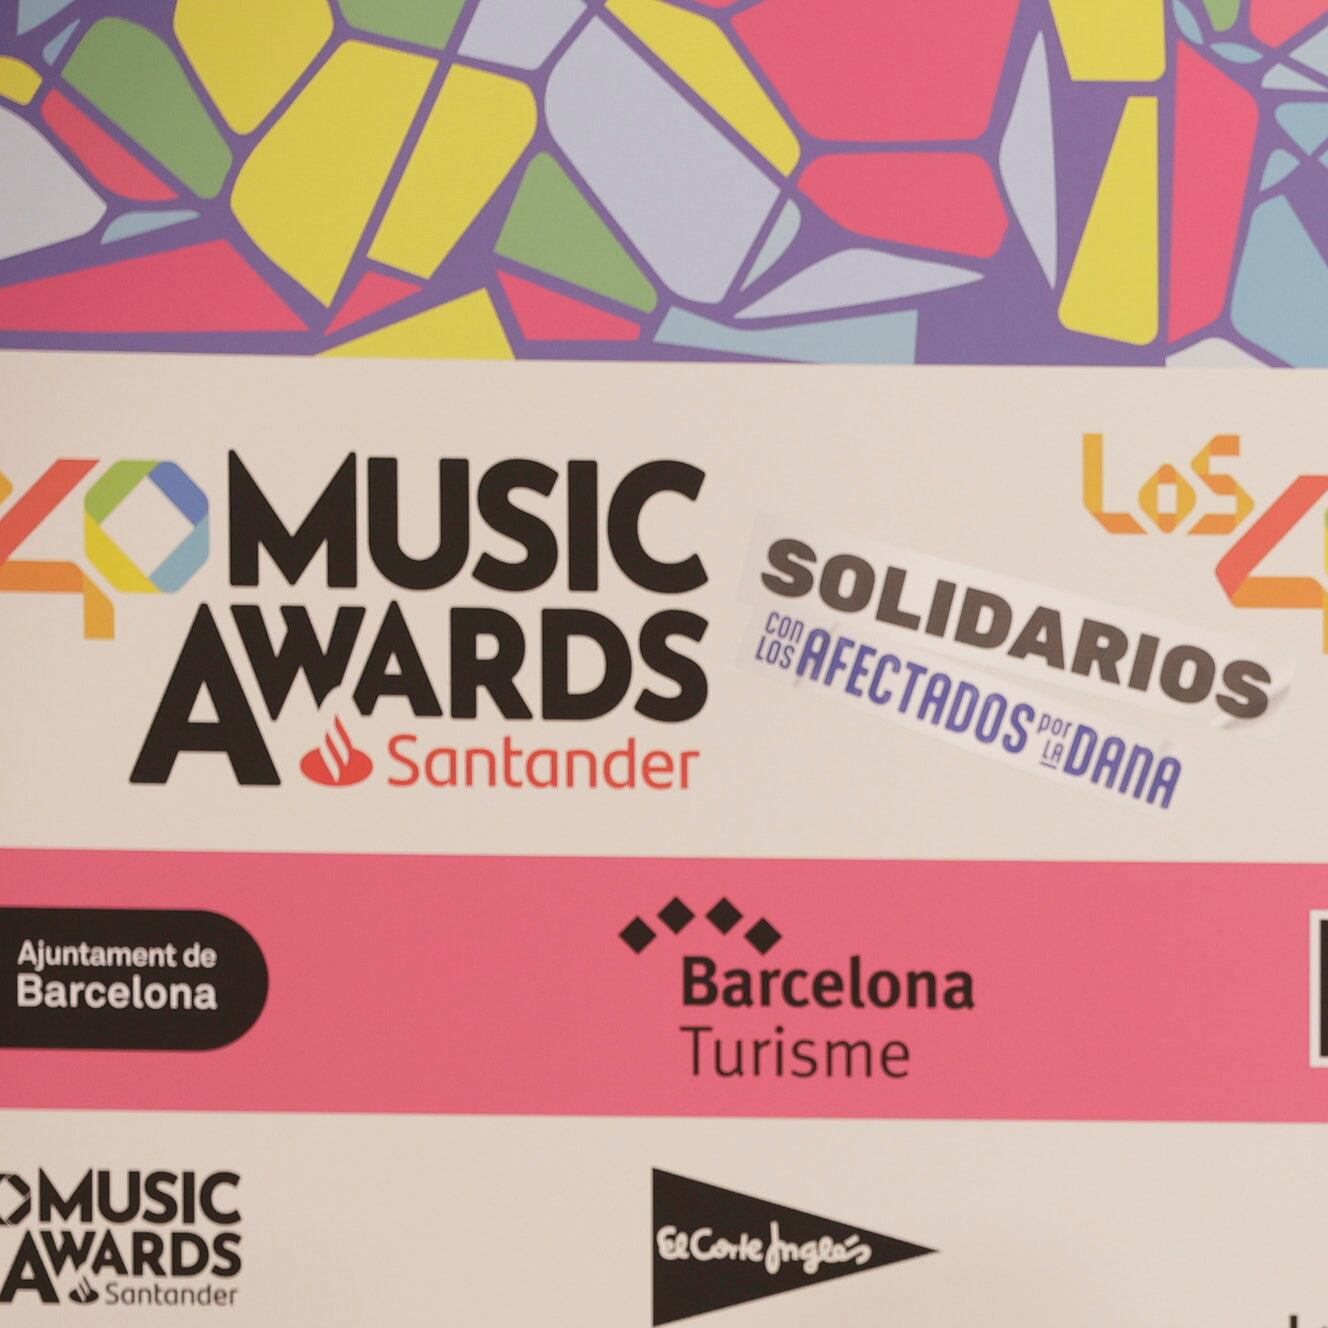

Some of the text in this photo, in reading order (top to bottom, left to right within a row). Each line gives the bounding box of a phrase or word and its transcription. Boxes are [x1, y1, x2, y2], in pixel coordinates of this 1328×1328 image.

[228, 449, 709, 594] MUSIC
[761, 538, 1272, 720] SOLIDARIOS
[129, 600, 710, 787] AWARDS
[755, 628, 1035, 754] LOS AFECTADOS
[387, 734, 701, 791] Santander
[1063, 724, 1181, 809] DANA
[17, 940, 218, 972] Ajuntament de
[682, 955, 974, 1010] Barcelona
[15, 973, 218, 1011] Barcelona
[680, 1025, 911, 1079] Turisme
[38, 1168, 241, 1224] MUSIC
[0, 1229, 242, 1303] AWARDS
[656, 1220, 872, 1275] El Corte Inglés
[106, 1283, 238, 1306] Santander
